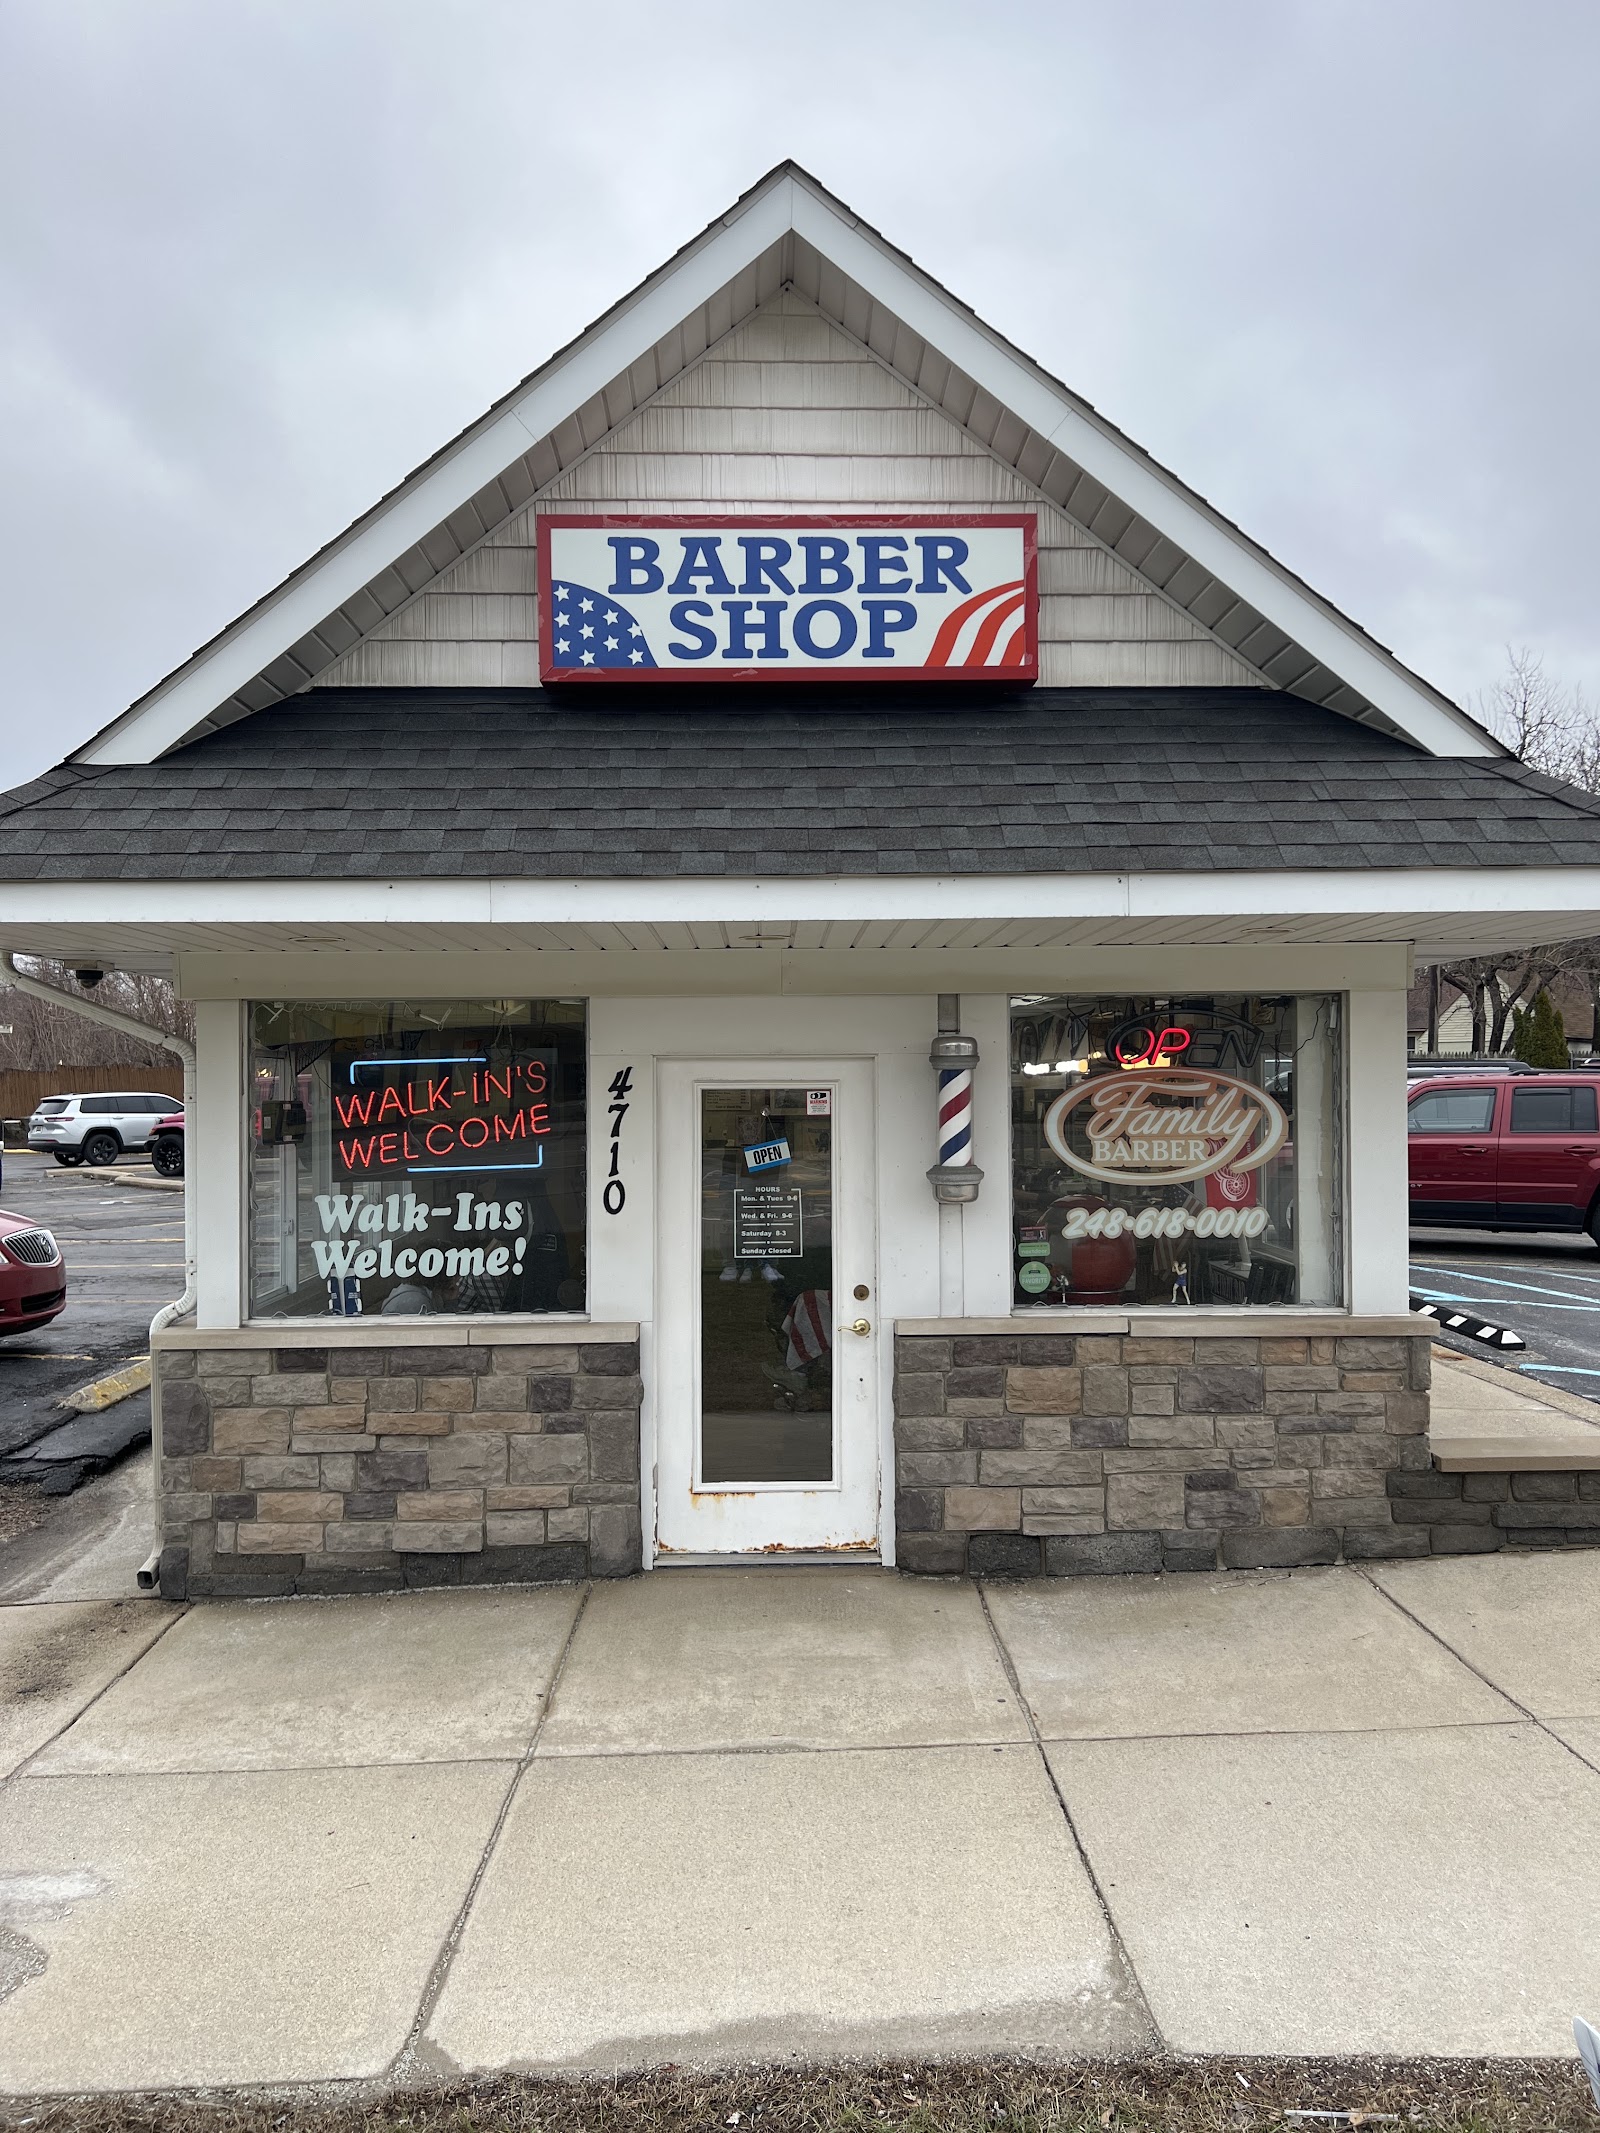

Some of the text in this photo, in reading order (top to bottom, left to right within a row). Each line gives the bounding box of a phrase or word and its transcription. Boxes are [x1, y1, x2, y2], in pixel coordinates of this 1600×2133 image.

[607, 536, 973, 596] BARBER
[668, 599, 918, 660] SHOP
[1115, 1026, 1264, 1068] OPEN
[334, 1060, 547, 1128] WALK-IN'S
[1090, 1081, 1257, 1139] Family
[338, 1102, 552, 1169] WELCOME
[603, 1066, 634, 1215] 4710
[753, 1145, 782, 1165] OPEN
[1093, 1140, 1208, 1162] BARBER
[314, 1192, 524, 1234] Walk-Ins
[741, 1230, 772, 1238] Saturday
[311, 1237, 527, 1280] Welcome!
[741, 1247, 767, 1255] Sunday
